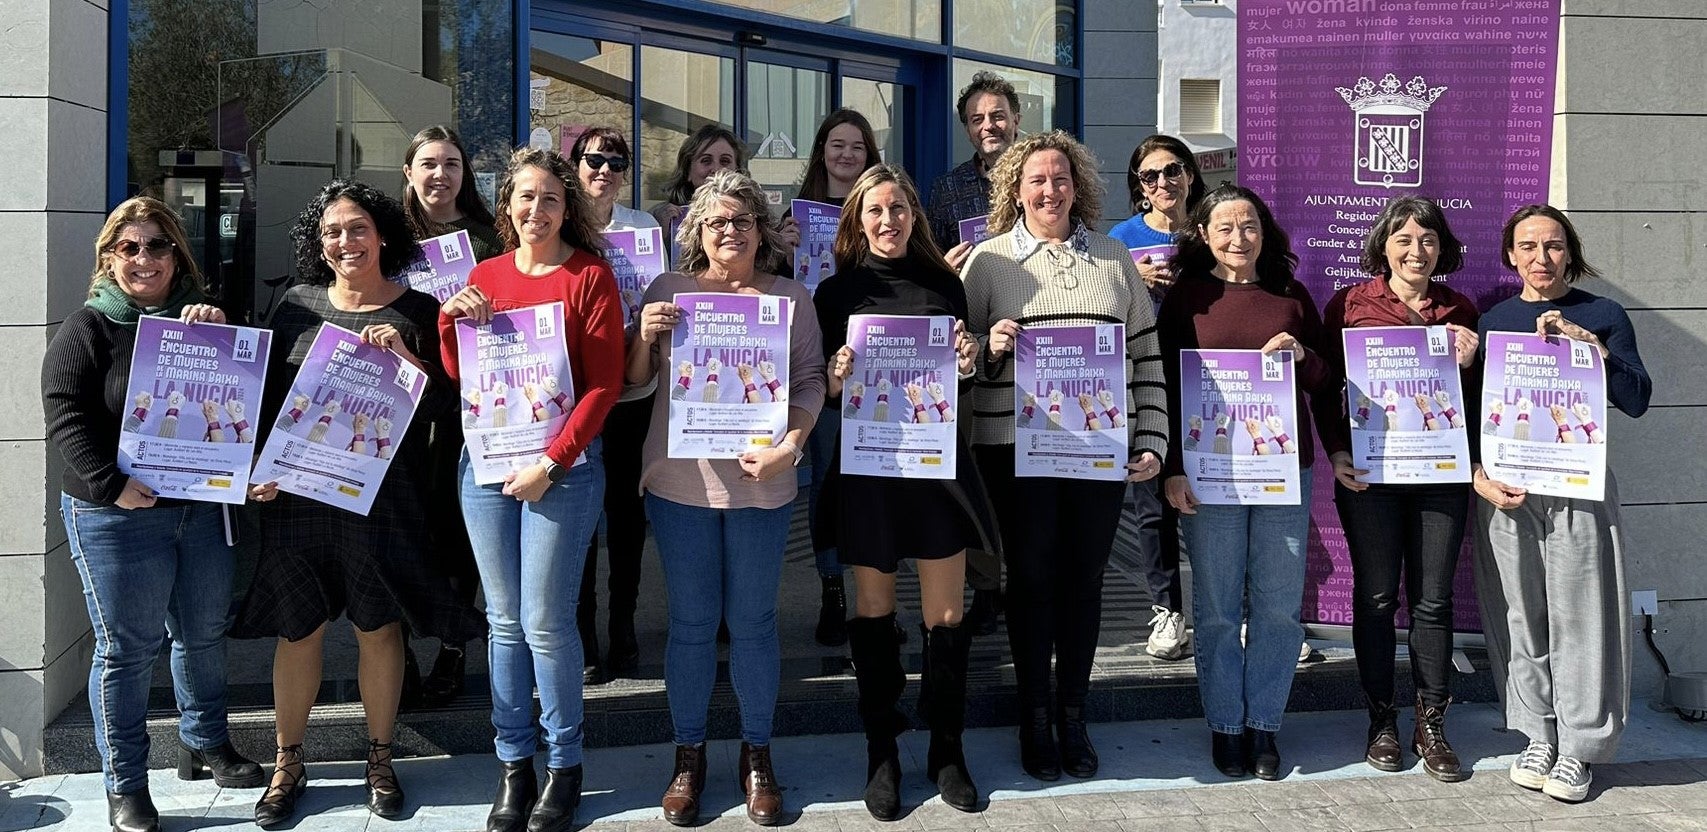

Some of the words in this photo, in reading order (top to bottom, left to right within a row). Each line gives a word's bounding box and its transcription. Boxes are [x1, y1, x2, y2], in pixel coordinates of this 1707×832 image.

[1247, 7, 1281, 17] mujer
[1286, 0, 1375, 14] woman
[1380, 2, 1411, 11] dona
[1415, 1, 1458, 10] femme
[1462, 1, 1486, 9] frau
[1516, 1, 1549, 9] жена
[1248, 21, 1271, 30] 女人
[1317, 19, 1346, 28] žena
[1356, 17, 1397, 27] kvinde
[1408, 16, 1452, 25] ženska
[1464, 15, 1501, 25] virino
[1512, 15, 1548, 24] naine
[1247, 35, 1312, 44] emakumea
[1318, 32, 1359, 41] nainen
[1364, 31, 1404, 41] muller
[1465, 30, 1511, 39] wahine
[1512, 103, 1542, 113] žena
[1247, 146, 1276, 154] konu
[1196, 153, 1226, 170] VENIL
[1304, 195, 1389, 206] AJUNTAMENT
[809, 215, 840, 224] ENCUENT
[1336, 210, 1380, 222] Regidori
[444, 245, 453, 253] 01
[1307, 238, 1344, 248] Gender
[1347, 240, 1356, 249] &
[447, 251, 459, 260] MAR
[763, 306, 771, 314] 01
[695, 311, 745, 322] ENCUENTRO
[540, 318, 547, 327] 01
[540, 327, 551, 335] MAR
[694, 324, 706, 333] DE
[708, 324, 747, 336] MUJERES
[933, 328, 941, 336] 01
[238, 340, 248, 350] 01
[703, 337, 737, 347] MARINA
[740, 337, 767, 347] BAIXA
[867, 335, 915, 346] ENCUENTRO
[1099, 336, 1107, 344] 01
[1431, 338, 1441, 346] 01
[160, 340, 218, 357] ENCUENTRO
[478, 350, 488, 359] DE
[490, 343, 528, 358] MUJERES
[867, 349, 877, 357] DE
[880, 347, 917, 358] MUJERES
[1036, 346, 1083, 356] ENCUENTRO
[1366, 347, 1416, 357] ENCUENTRO
[1575, 349, 1584, 357] 01
[237, 350, 252, 359] MAR
[694, 348, 712, 366] LA
[1505, 352, 1556, 365] ENCUENTRO
[158, 354, 172, 365] DE
[173, 355, 219, 371] MUJERES
[331, 351, 383, 376] ENCUENTRO
[486, 358, 520, 371] MARINA
[521, 353, 547, 368] BAIXA
[873, 358, 907, 368] MARINA
[909, 359, 936, 368] BAIXA
[1036, 359, 1046, 367] DE
[1049, 357, 1085, 368] MUJERES
[1266, 362, 1274, 371] 01
[1367, 359, 1378, 368] DE
[1381, 358, 1419, 368] MUJERES
[1576, 358, 1589, 366] MAR
[326, 362, 338, 374] DE
[340, 367, 381, 386] MUJERES
[401, 370, 409, 380] 01
[1044, 369, 1077, 378] MARINA
[1080, 368, 1104, 378] BAIXA
[1202, 369, 1248, 380] ENCUENTRO
[1377, 369, 1411, 378] MARINA
[1414, 368, 1439, 378] BAIXA
[1505, 365, 1515, 374] DE
[1518, 366, 1559, 376] MUJERES
[166, 367, 206, 382] MARINA
[208, 372, 239, 386] BAIXA
[865, 370, 882, 387] LA
[398, 378, 410, 388] MAR
[480, 372, 497, 393] LA
[1202, 382, 1211, 390] DE
[1214, 380, 1252, 392] MUJERES
[1512, 376, 1548, 388] MARINA
[1551, 377, 1580, 390] BAIXA
[153, 380, 176, 400] LA
[329, 377, 366, 396] MARINA
[368, 389, 394, 405] BAIXA
[1037, 381, 1054, 398] LA
[1370, 381, 1388, 398] LA
[312, 386, 335, 406] LA
[1210, 392, 1243, 402] MARINA
[1245, 392, 1272, 403] BAIXA
[1504, 387, 1522, 405] LA
[1203, 403, 1220, 421] LA
